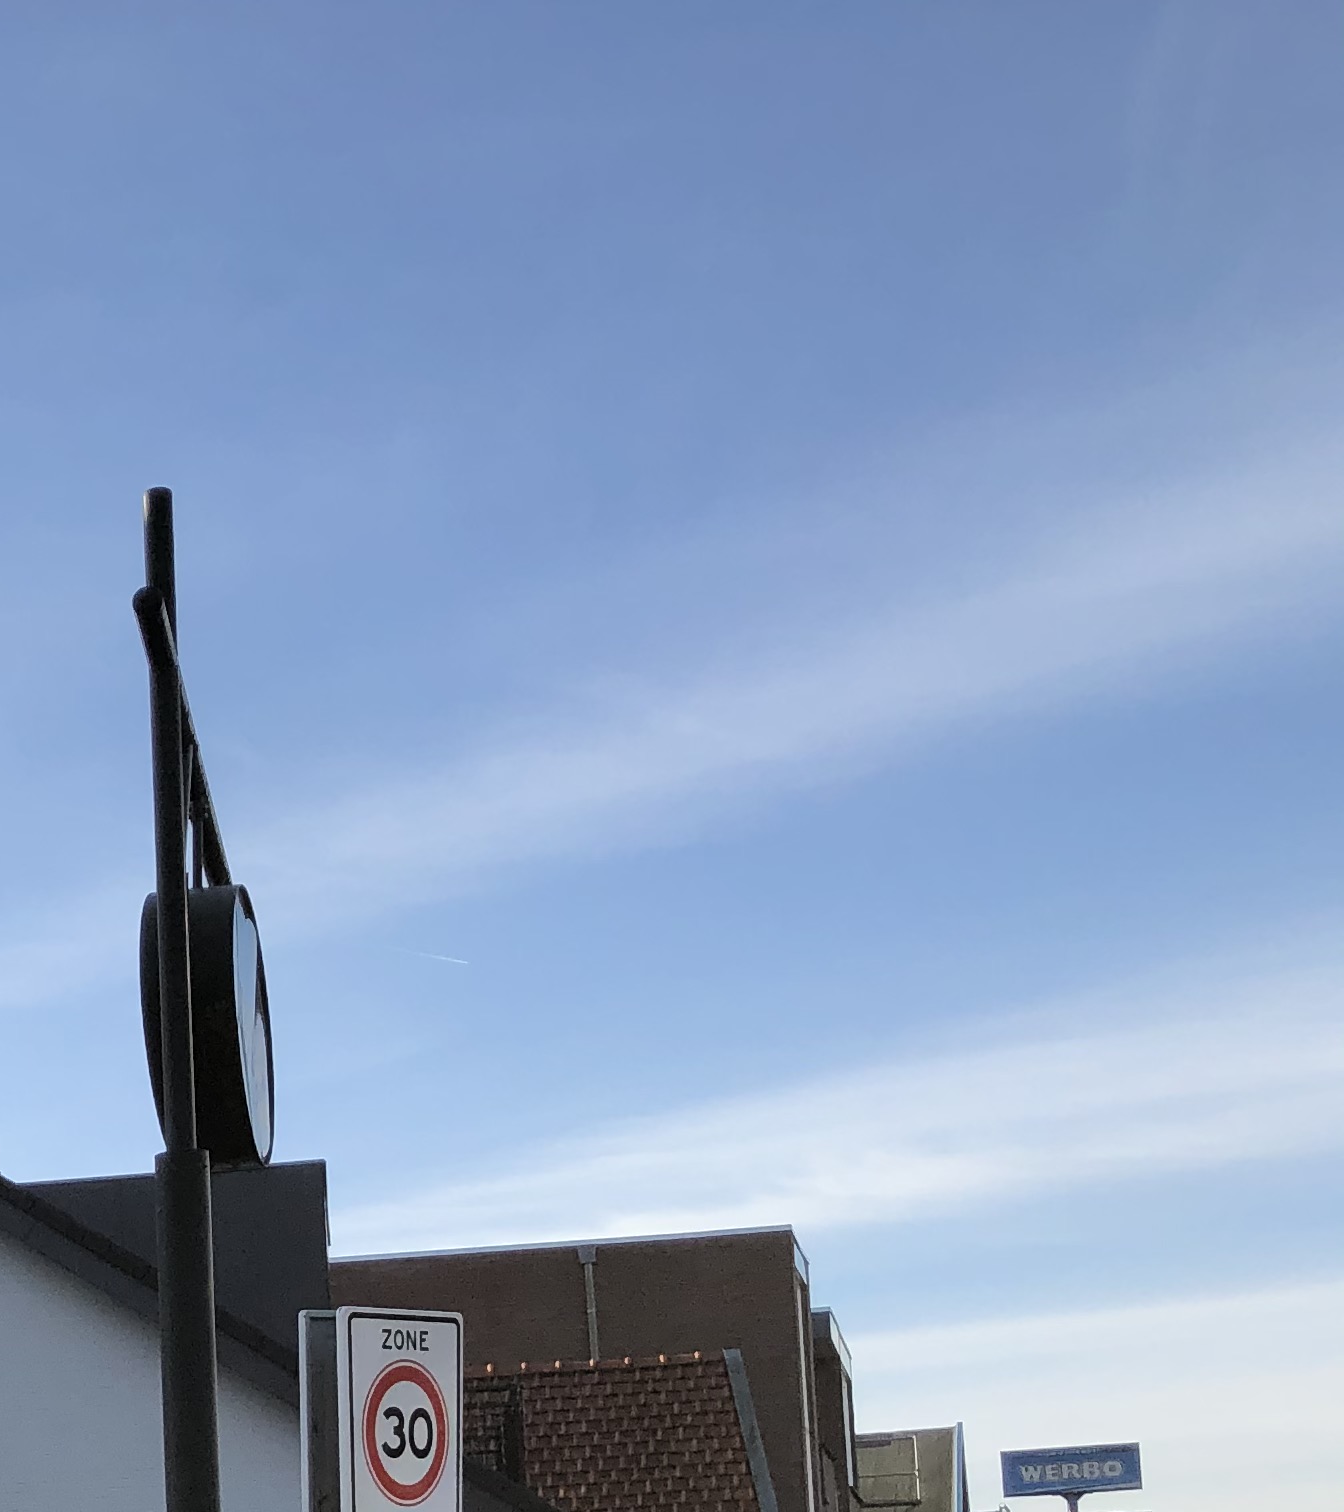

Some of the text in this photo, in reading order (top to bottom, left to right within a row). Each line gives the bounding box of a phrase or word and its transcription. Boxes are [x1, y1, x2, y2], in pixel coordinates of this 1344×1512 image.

[381, 1328, 430, 1352] ZONE
[381, 1406, 434, 1459] 30
[1020, 1460, 1123, 1483] WERBO
